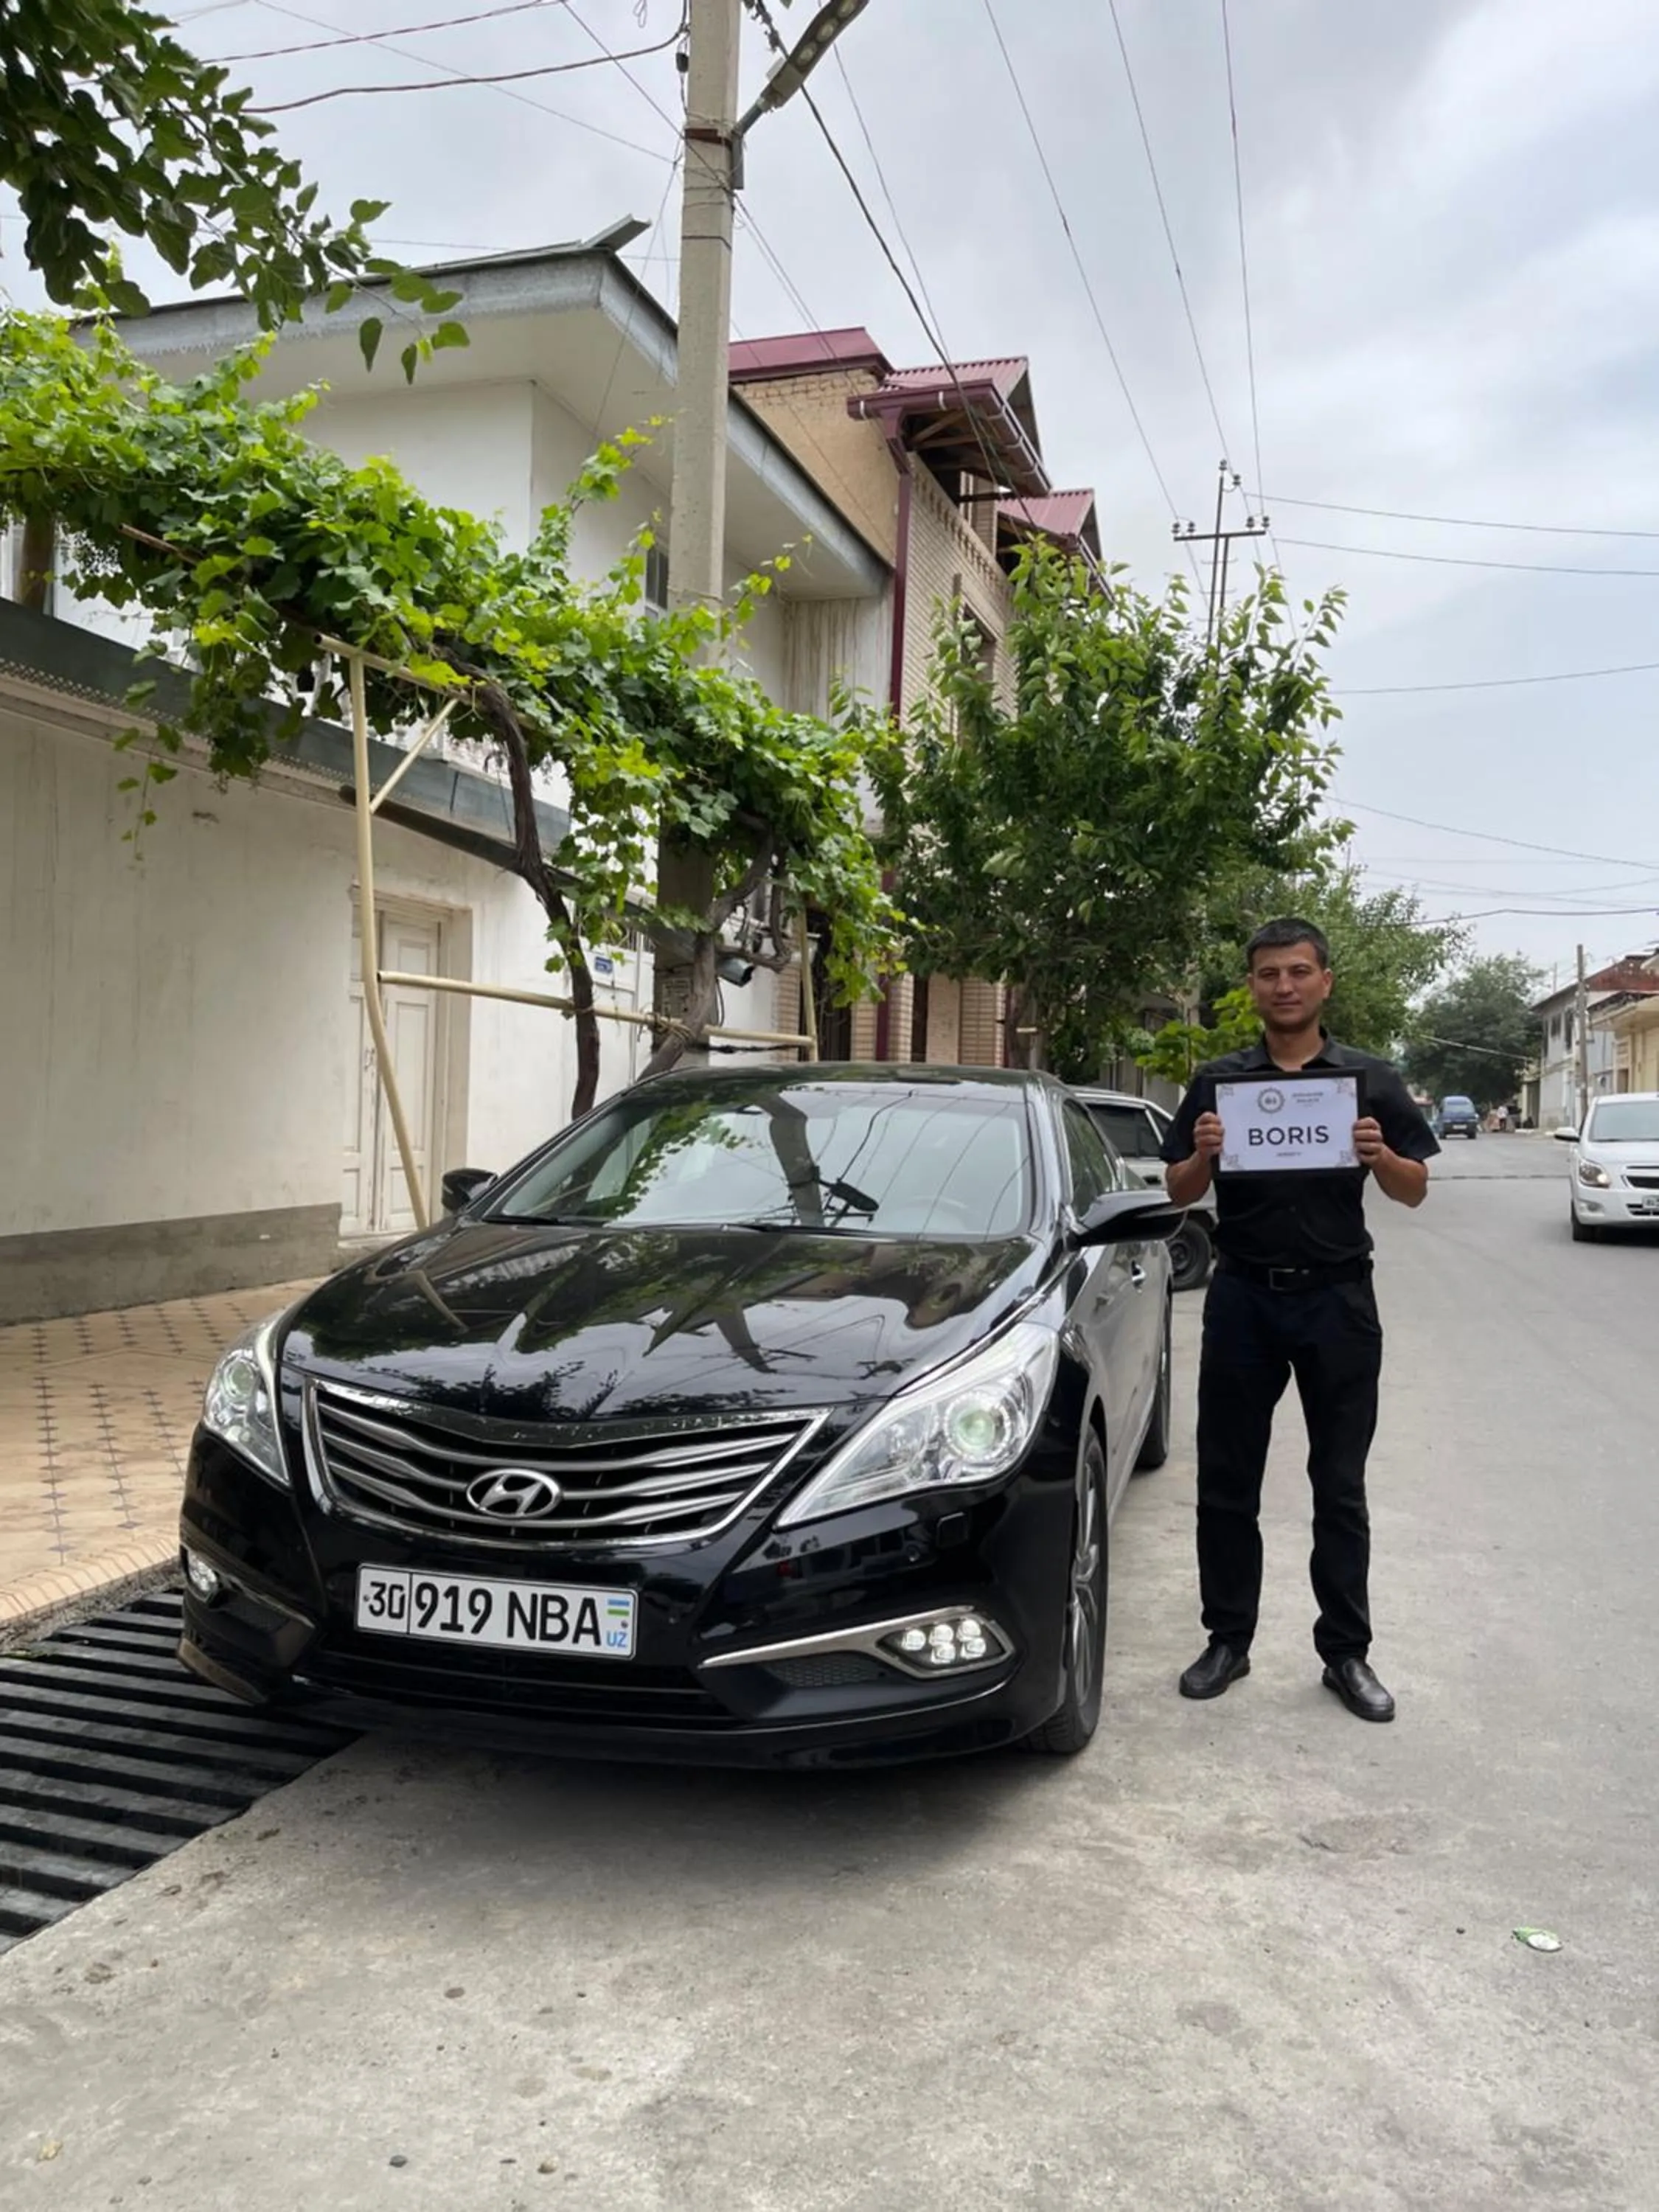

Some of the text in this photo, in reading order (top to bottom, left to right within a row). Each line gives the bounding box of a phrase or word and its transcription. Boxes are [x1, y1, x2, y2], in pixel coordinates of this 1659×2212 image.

[1248, 1125, 1329, 1146] BORIS
[368, 1581, 601, 1646] 30 919 NBA
[606, 1631, 627, 1647] UZ
